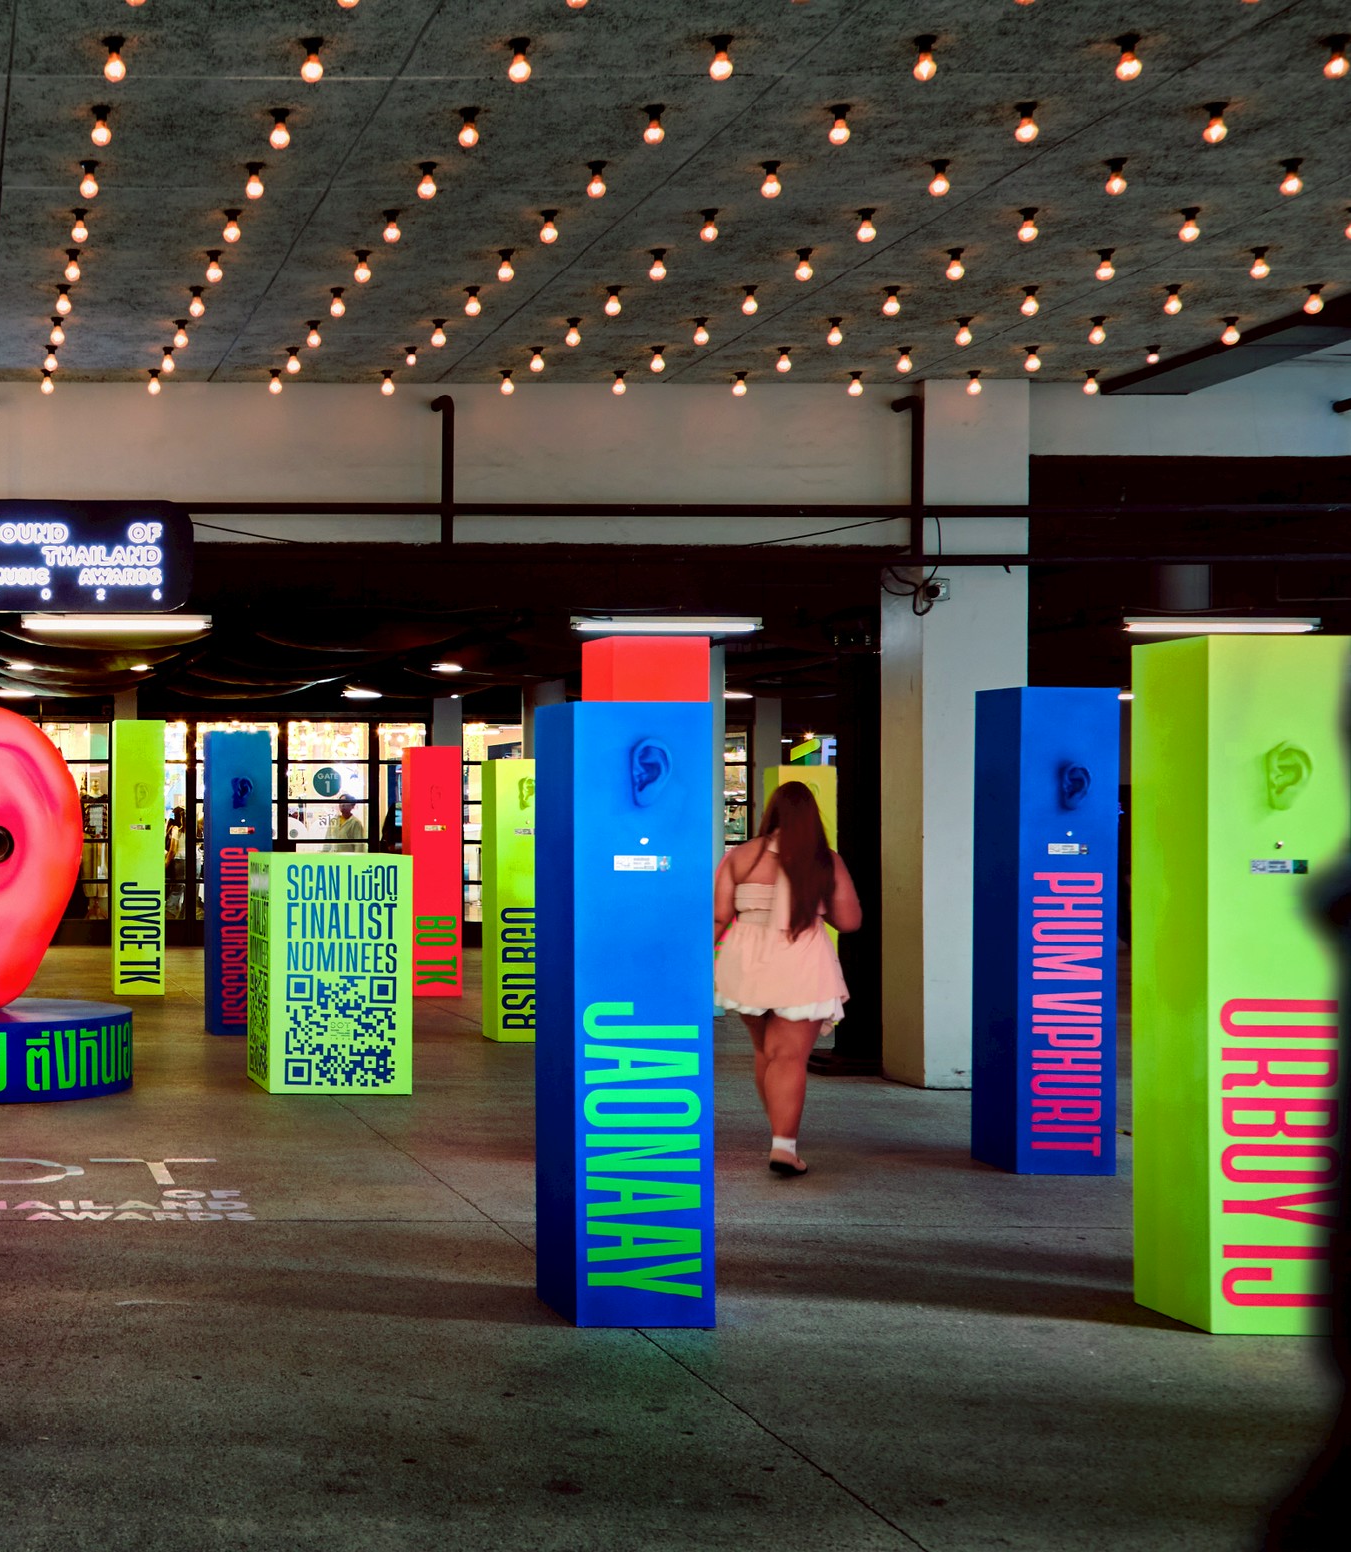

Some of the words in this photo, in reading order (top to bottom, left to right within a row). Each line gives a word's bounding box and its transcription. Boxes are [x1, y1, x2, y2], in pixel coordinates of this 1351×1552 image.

[129, 523, 162, 543] OF
[41, 546, 162, 566] THAILAND
[78, 568, 162, 585] AWARDS
[325, 781, 330, 793] 1
[286, 864, 340, 901] SCAN
[120, 882, 160, 951] JOYCE
[286, 903, 398, 940] FINALIST
[415, 916, 457, 946] BO
[1032, 872, 1103, 980] PHUM
[286, 942, 398, 974] NOMINEES
[416, 956, 457, 985] TK
[120, 961, 161, 985] TK
[1030, 992, 1102, 1157] VIPHURIT
[583, 1001, 702, 1298] JAONAAY
[161, 1189, 242, 1199] OF
[25, 1211, 256, 1221] AWARDS
